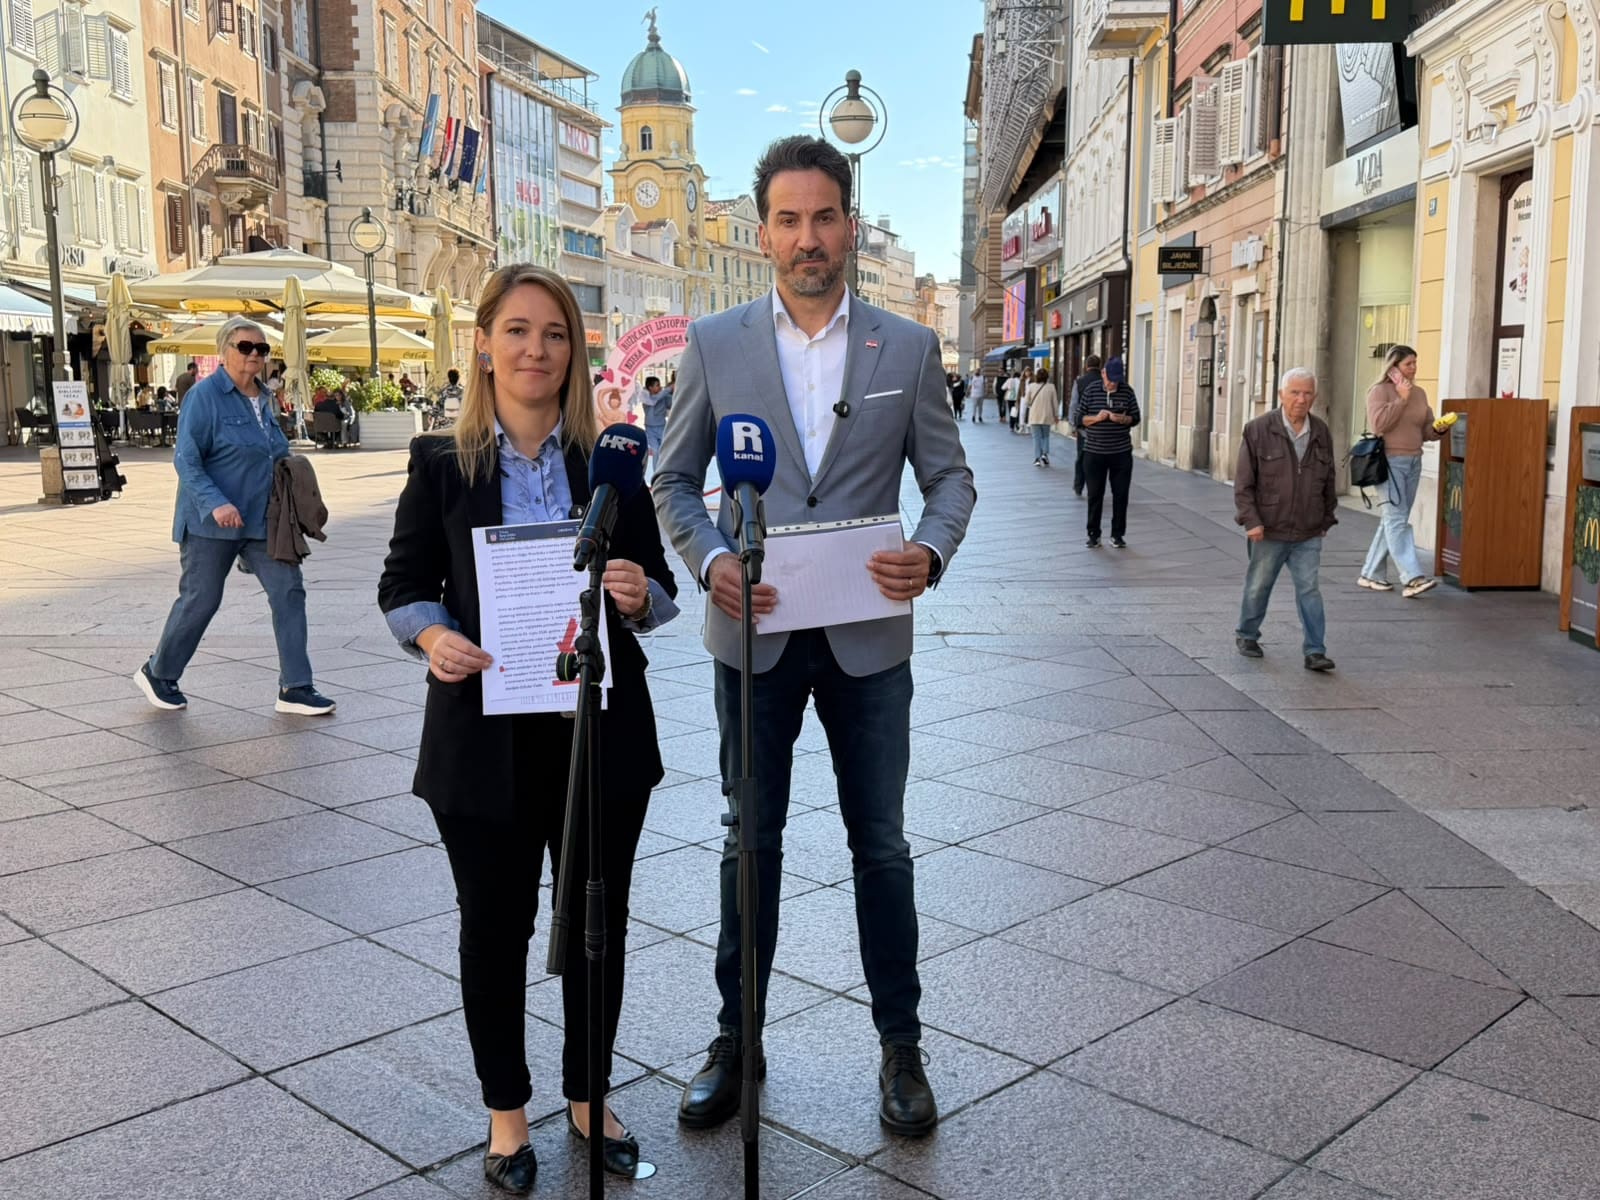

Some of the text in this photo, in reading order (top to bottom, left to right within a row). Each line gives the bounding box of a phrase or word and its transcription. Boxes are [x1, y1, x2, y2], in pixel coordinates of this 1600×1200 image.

[1170, 251, 1192, 260] JAVNI
[600, 434, 641, 456] HRT
[734, 451, 763, 462] kanal
